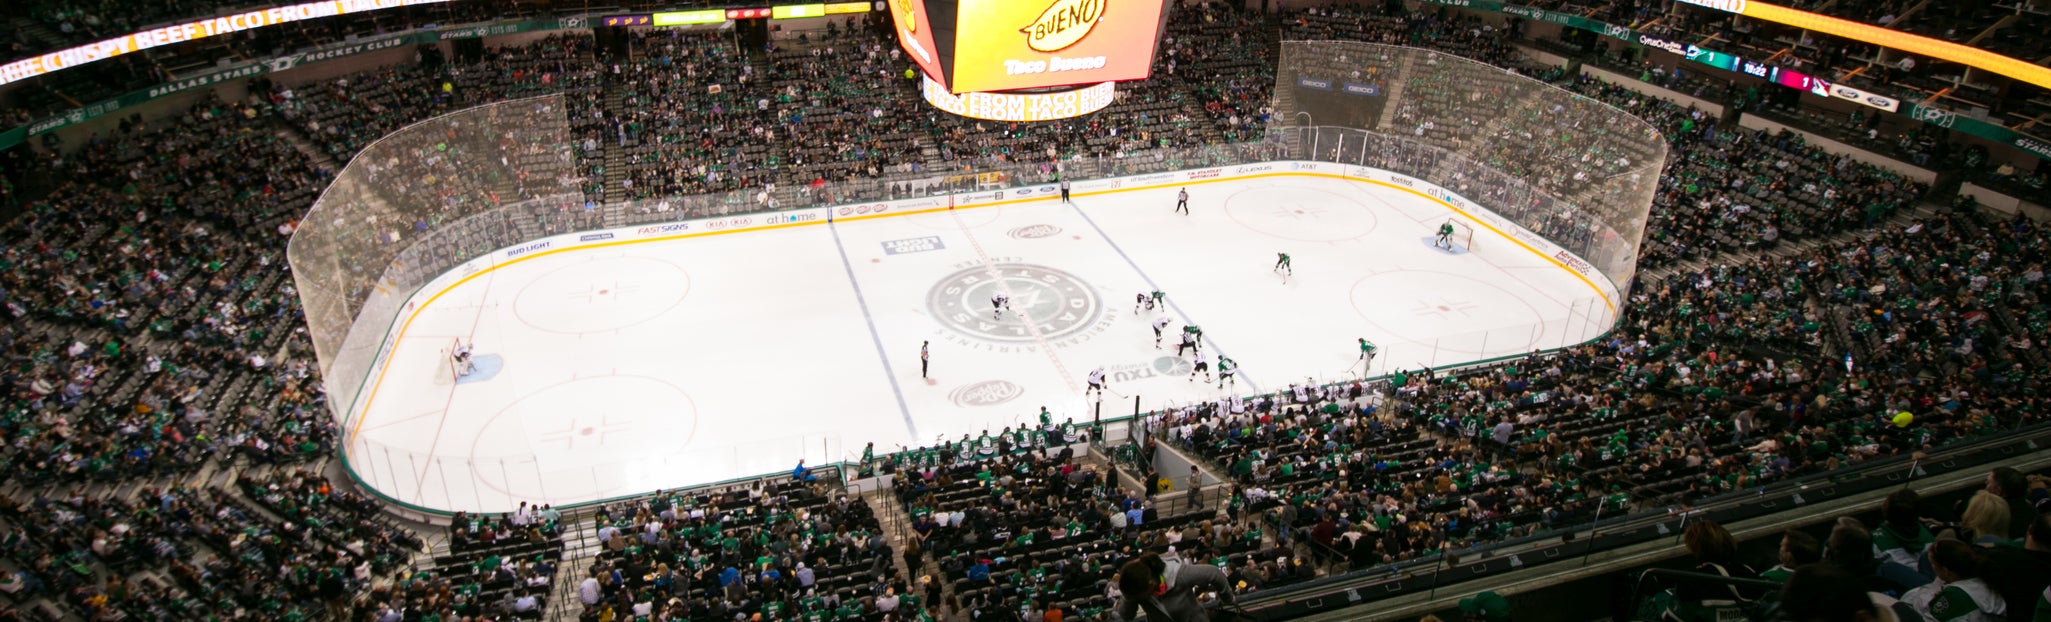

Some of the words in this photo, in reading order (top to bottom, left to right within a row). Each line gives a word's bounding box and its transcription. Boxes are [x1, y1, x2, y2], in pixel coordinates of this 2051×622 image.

[134, 23, 197, 49] BEEF
[200, 11, 264, 37] TACO
[267, 1, 338, 25] FROM
[1035, 0, 1098, 40] BUENO
[306, 46, 362, 62] HOCKEY
[367, 39, 401, 50] CLUB
[1708, 52, 1715, 62] 1
[1004, 59, 1046, 75] Taco
[1049, 56, 1106, 72] Bueno
[1743, 62, 1767, 77] 19:22
[150, 77, 207, 98] DALLAS
[213, 65, 261, 83] STARS
[1348, 85, 1374, 94] GEICO
[1802, 77, 1810, 88] 1
[29, 116, 66, 135] STARS
[1427, 186, 1438, 196] at
[767, 216, 778, 225] at
[507, 247, 525, 257] BUD
[526, 241, 551, 253] LIGHT
